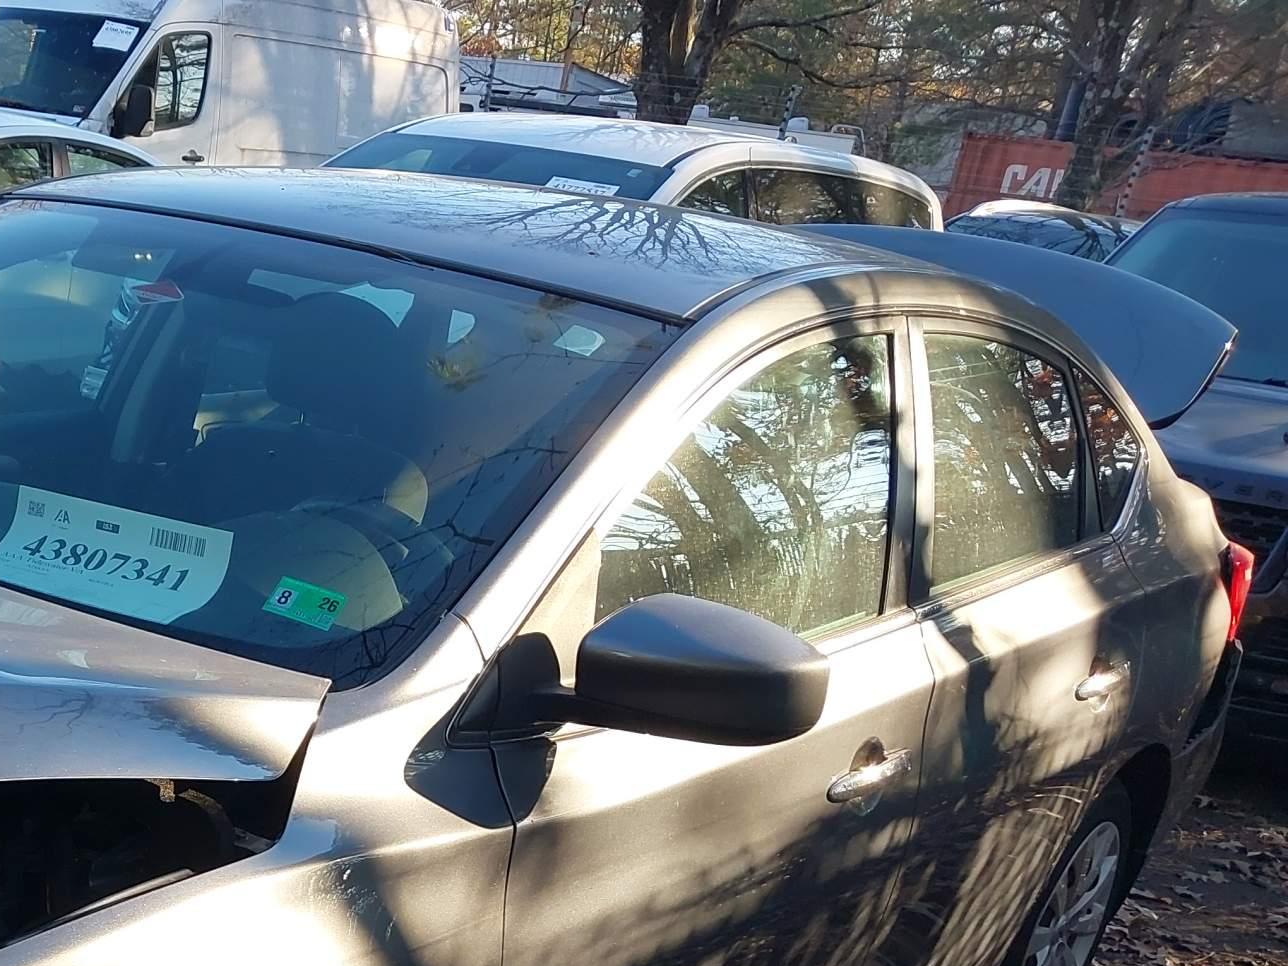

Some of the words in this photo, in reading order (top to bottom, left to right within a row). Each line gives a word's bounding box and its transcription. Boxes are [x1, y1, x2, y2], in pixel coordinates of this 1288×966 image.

[22, 535, 191, 592] 43807341
[277, 590, 292, 605] 8
[318, 597, 340, 612] 26
